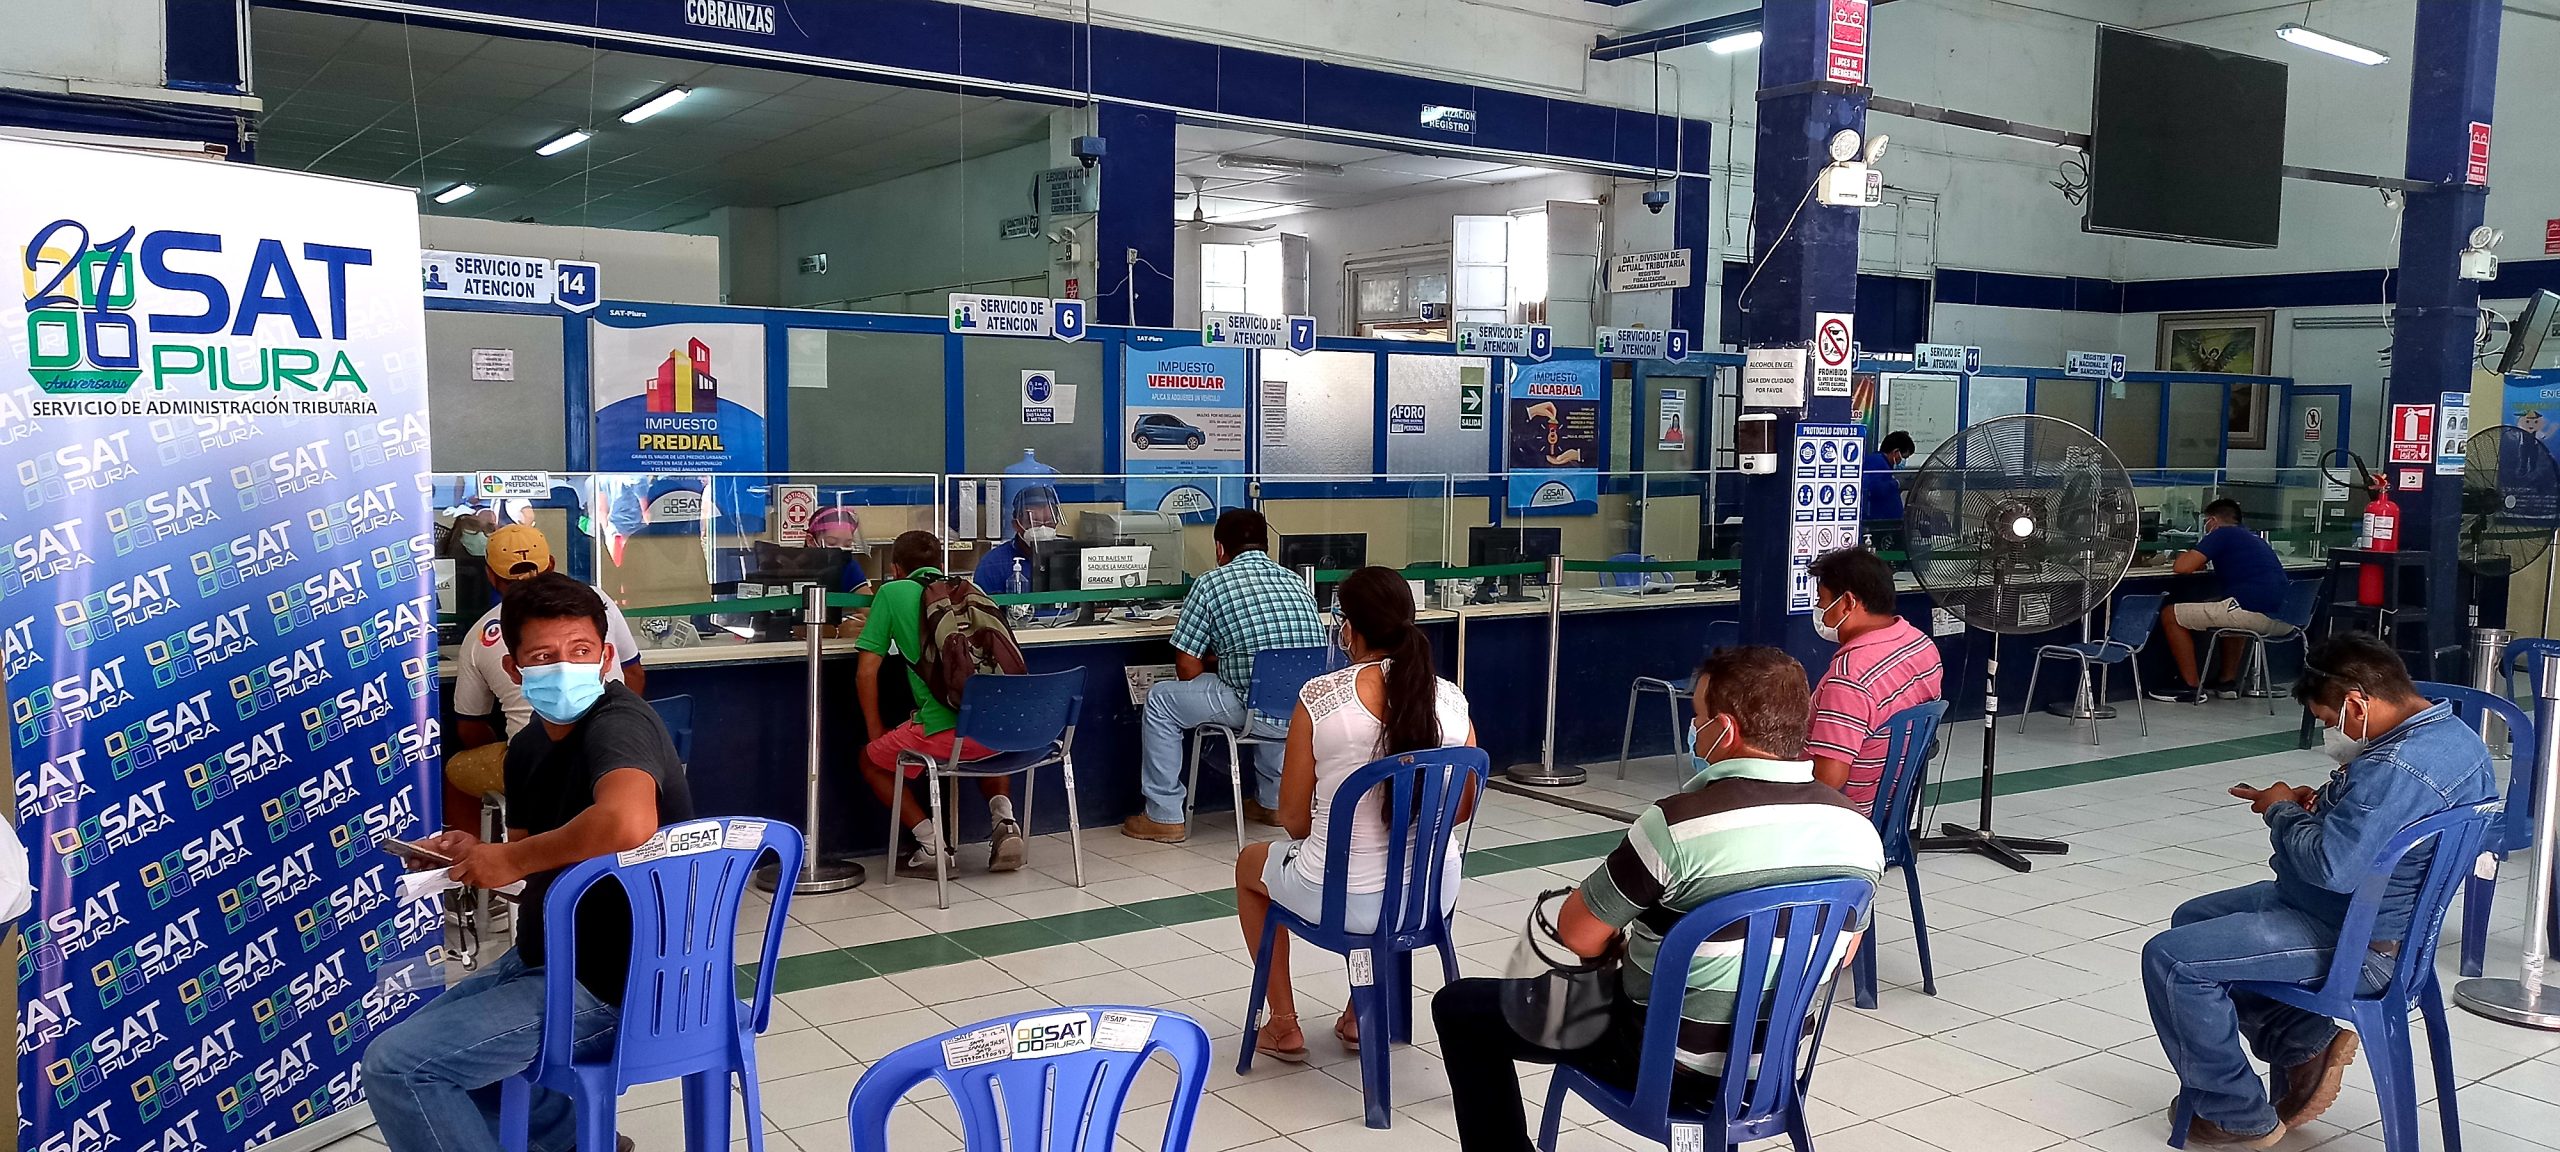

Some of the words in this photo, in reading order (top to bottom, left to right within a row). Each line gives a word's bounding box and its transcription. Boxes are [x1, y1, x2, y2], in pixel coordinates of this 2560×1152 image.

[687, 0, 773, 33] COBRANZAS
[1835, 57, 1850, 67] LUCES
[1851, 59, 1858, 68] DE
[1430, 119, 1469, 131] REGISTRO
[1623, 256, 1635, 264] DAT
[1640, 252, 1669, 262] DIVISION
[1671, 251, 1680, 259] DE
[1646, 259, 1685, 270] TRIBUTARIA
[455, 257, 521, 277] SERVICIO
[525, 262, 543, 279] DE
[140, 229, 372, 340] SAT
[464, 278, 534, 298] ATENCION
[559, 271, 585, 295] 14
[980, 298, 1028, 314] SERVICIO
[1031, 301, 1043, 315] DE
[1422, 305, 1433, 315] 37
[986, 316, 1038, 332] ATENCION
[1063, 309, 1075, 329] 6
[1228, 315, 1268, 330] SERVICIO
[1271, 318, 1281, 331] DE
[1233, 331, 1276, 346] ATENCION
[1297, 325, 1308, 343] 7
[1478, 326, 1511, 338] SERVICIO
[1514, 327, 1524, 339] DE
[1617, 329, 1650, 342] SERVICIO
[1651, 331, 1661, 342] DE
[1482, 340, 1519, 353] ATENCION
[1537, 333, 1545, 349] 8
[1673, 336, 1681, 352] 9
[1621, 343, 1657, 356] ATENCION
[1930, 347, 1953, 358] SERVICIO
[1954, 348, 1962, 358] DE
[1157, 360, 1215, 374] IMPUESTO
[1932, 359, 1958, 369] ATENCION
[1967, 352, 1978, 367] 11
[2112, 361, 2122, 373] 12
[153, 345, 368, 393] PIURA
[1534, 371, 1578, 382] IMPUESTO
[1818, 368, 1848, 376] PROHIBIDO
[44, 375, 127, 390] Aniversario
[1147, 374, 1225, 390] VEHICULAR
[1528, 384, 1583, 396] ALCABALA
[2541, 390, 2554, 398] EN
[33, 399, 116, 416] SERVICIO
[121, 399, 142, 415] DE
[146, 396, 289, 415] ADMINISTRACIÓN
[293, 399, 378, 415] TRIBUTARIA
[1391, 406, 1425, 419] AFORO
[645, 417, 717, 431] IMPUESTO
[1461, 418, 1481, 427] SALIDA
[1803, 426, 1833, 436] PROTOCOLO
[1833, 427, 1849, 436] COVID
[1849, 427, 1858, 436] 19
[638, 433, 724, 451] PREDIAL
[56, 430, 130, 476] SAT
[67, 463, 138, 496] PIURA
[510, 473, 538, 481] ATENCIÓN
[2408, 475, 2416, 484] 2
[1183, 493, 1201, 503] SAT
[1551, 488, 1565, 497] SAT
[346, 482, 398, 524] SAT
[354, 510, 404, 539] PIURA
[304, 560, 363, 607] SAT
[313, 587, 368, 618] PIURA
[267, 639, 327, 685] SAT
[275, 669, 332, 702] PIURA
[223, 722, 286, 772] SAT
[233, 754, 293, 790] PIURA
[183, 815, 245, 863] SAT
[690, 827, 719, 843] SAT
[192, 849, 252, 886] PIURA
[49, 881, 121, 935] SAT
[62, 917, 129, 961] PIURA
[92, 1000, 161, 1054] SAT
[1110, 1015, 1127, 1023] SATP
[1045, 1020, 1087, 1042] SAT
[1045, 1038, 1085, 1050] PIURA
[102, 1032, 168, 1079] PIURA
